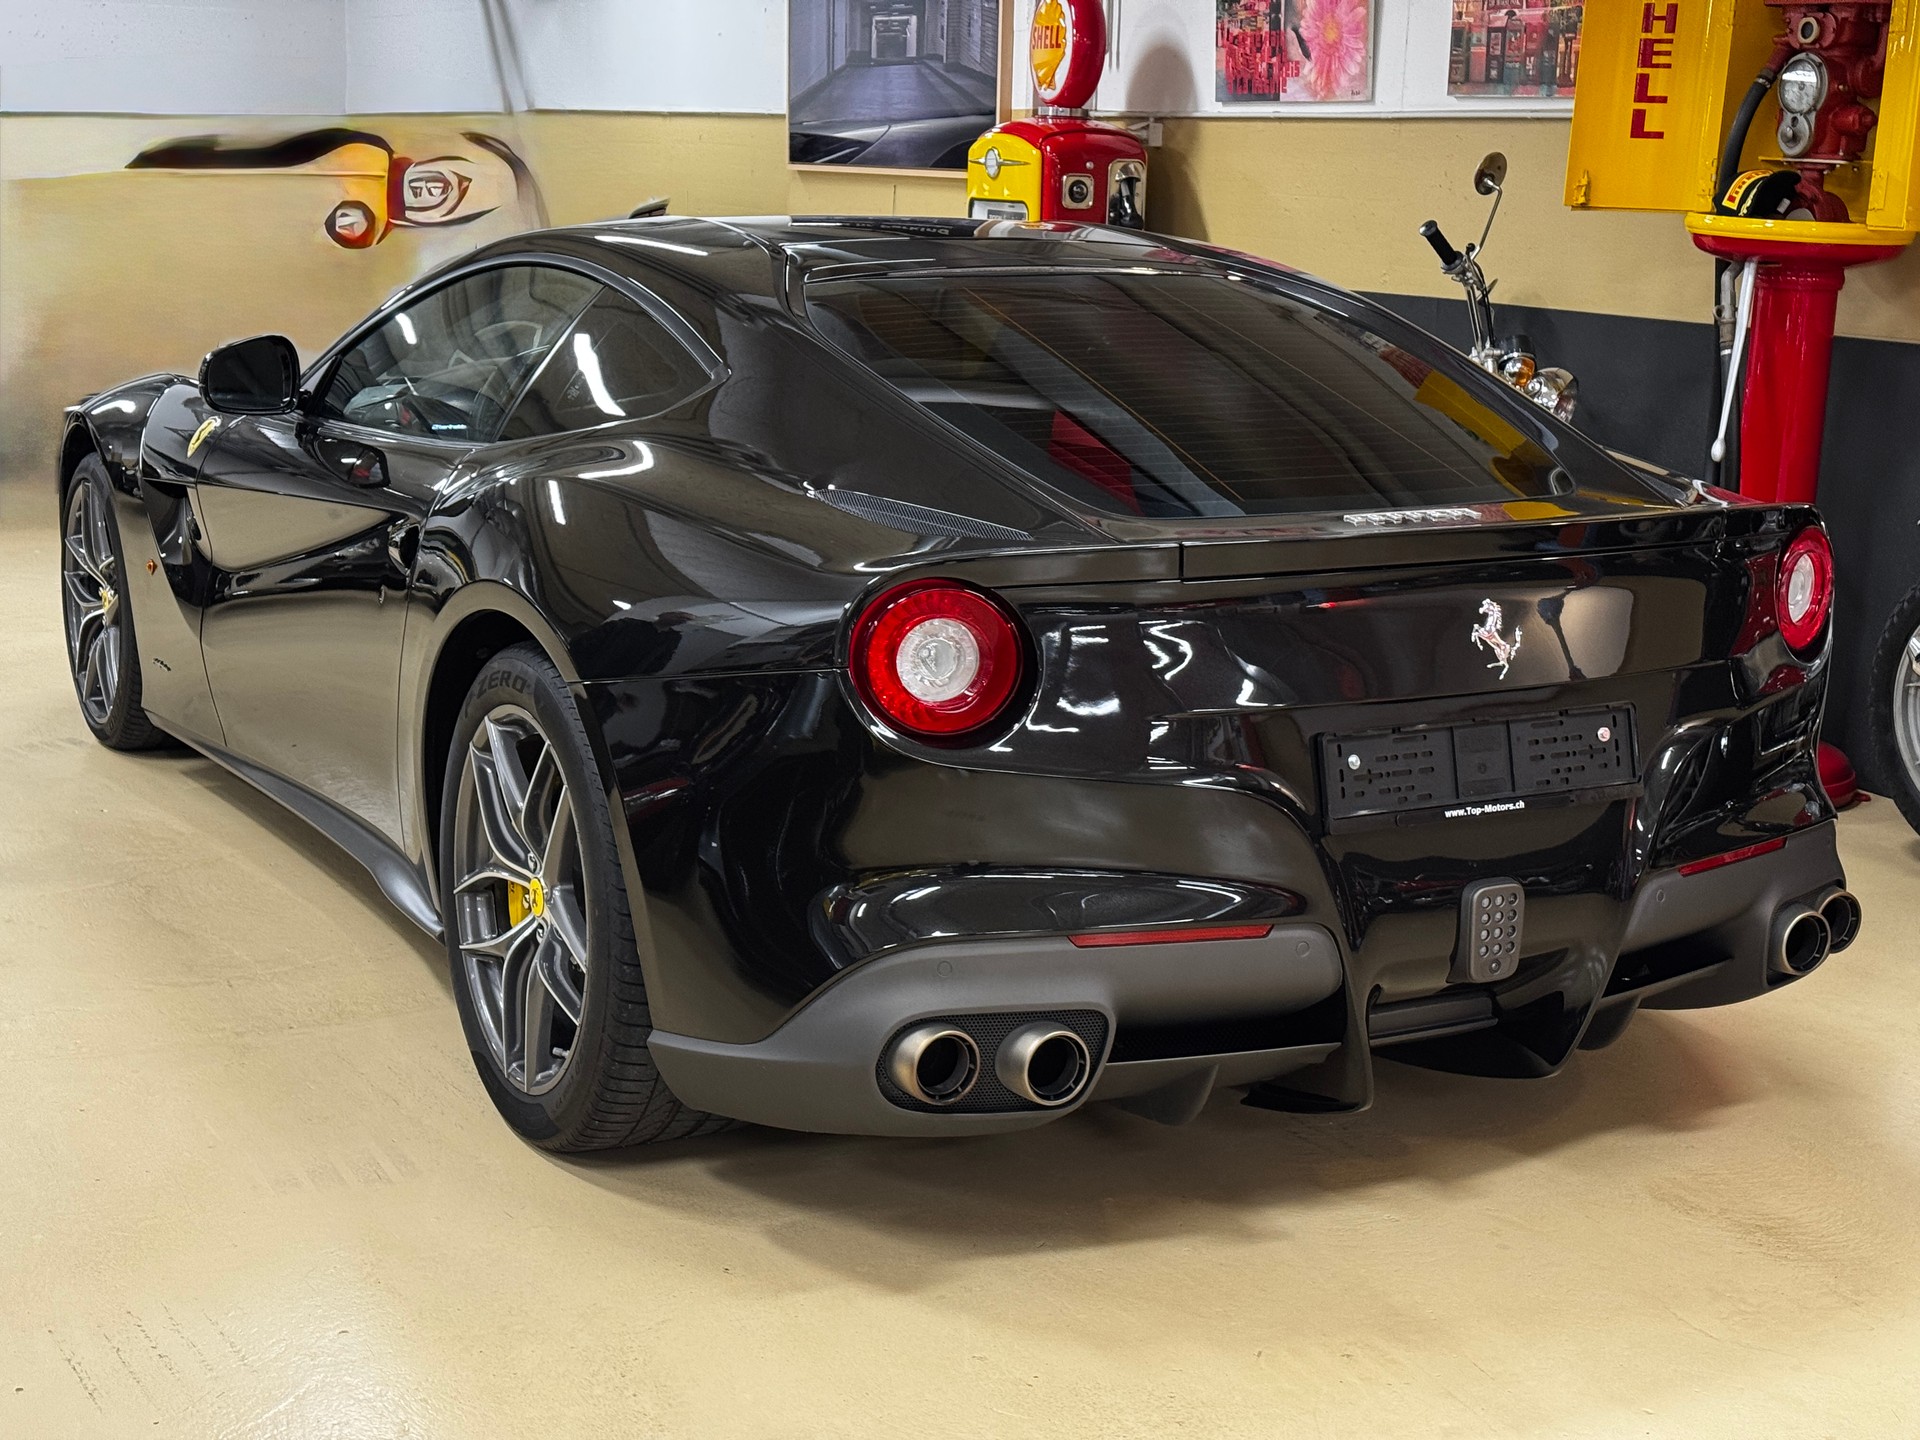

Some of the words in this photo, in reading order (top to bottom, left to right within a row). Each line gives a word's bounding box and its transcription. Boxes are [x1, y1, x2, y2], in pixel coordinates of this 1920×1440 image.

[1032, 25, 1061, 49] SHELL
[477, 670, 527, 699] ZERO
[1444, 799, 1525, 818] www.Top-Motors.ch
